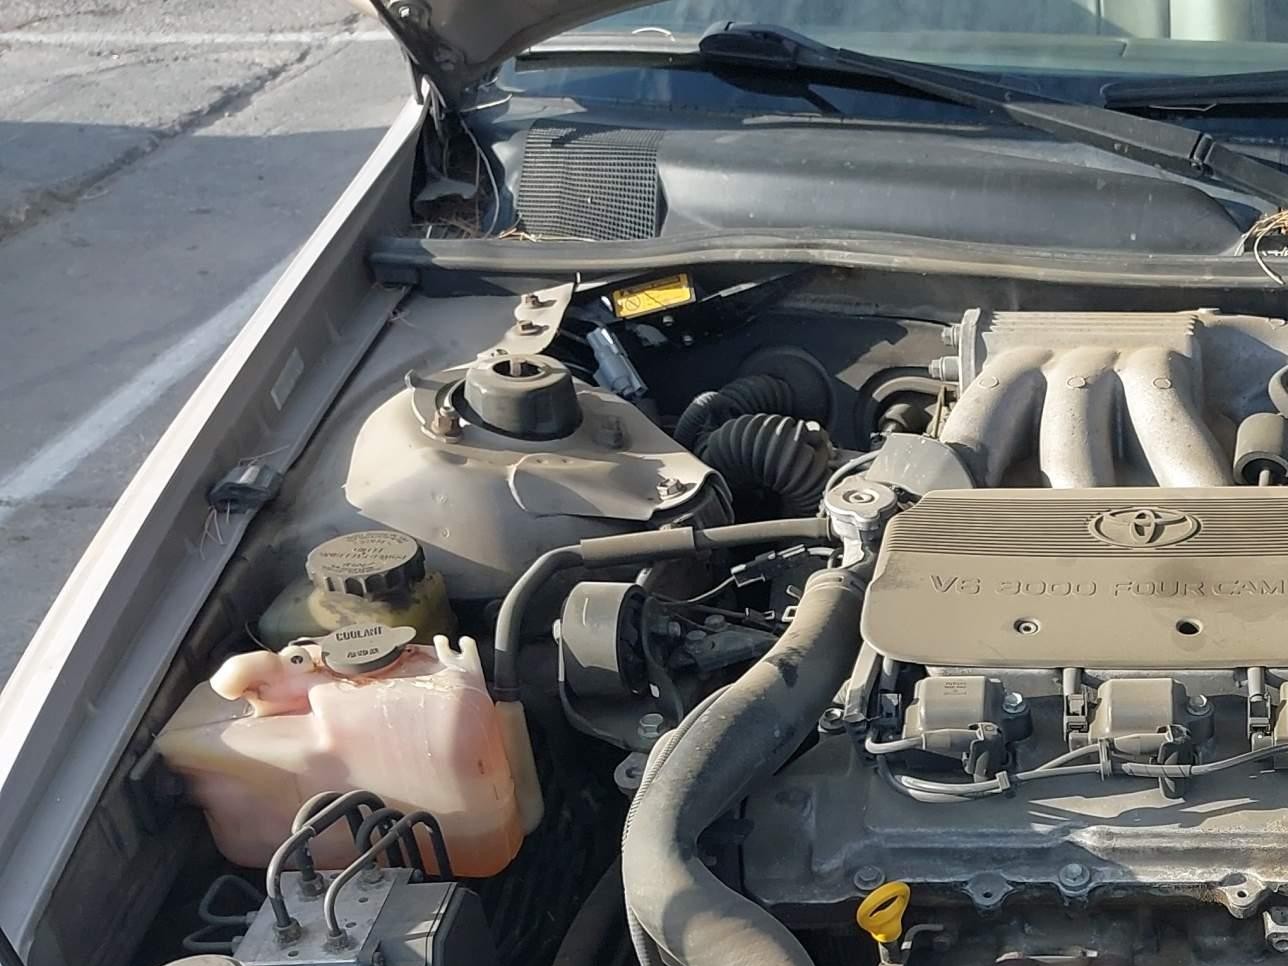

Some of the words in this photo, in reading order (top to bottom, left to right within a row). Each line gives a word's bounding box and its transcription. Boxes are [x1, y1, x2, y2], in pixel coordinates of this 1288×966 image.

[930, 575, 981, 595] V6
[999, 580, 1097, 596] 3000
[1114, 580, 1205, 597] FOUR
[1213, 579, 1286, 597] CAM
[335, 626, 383, 641] COOLANT
